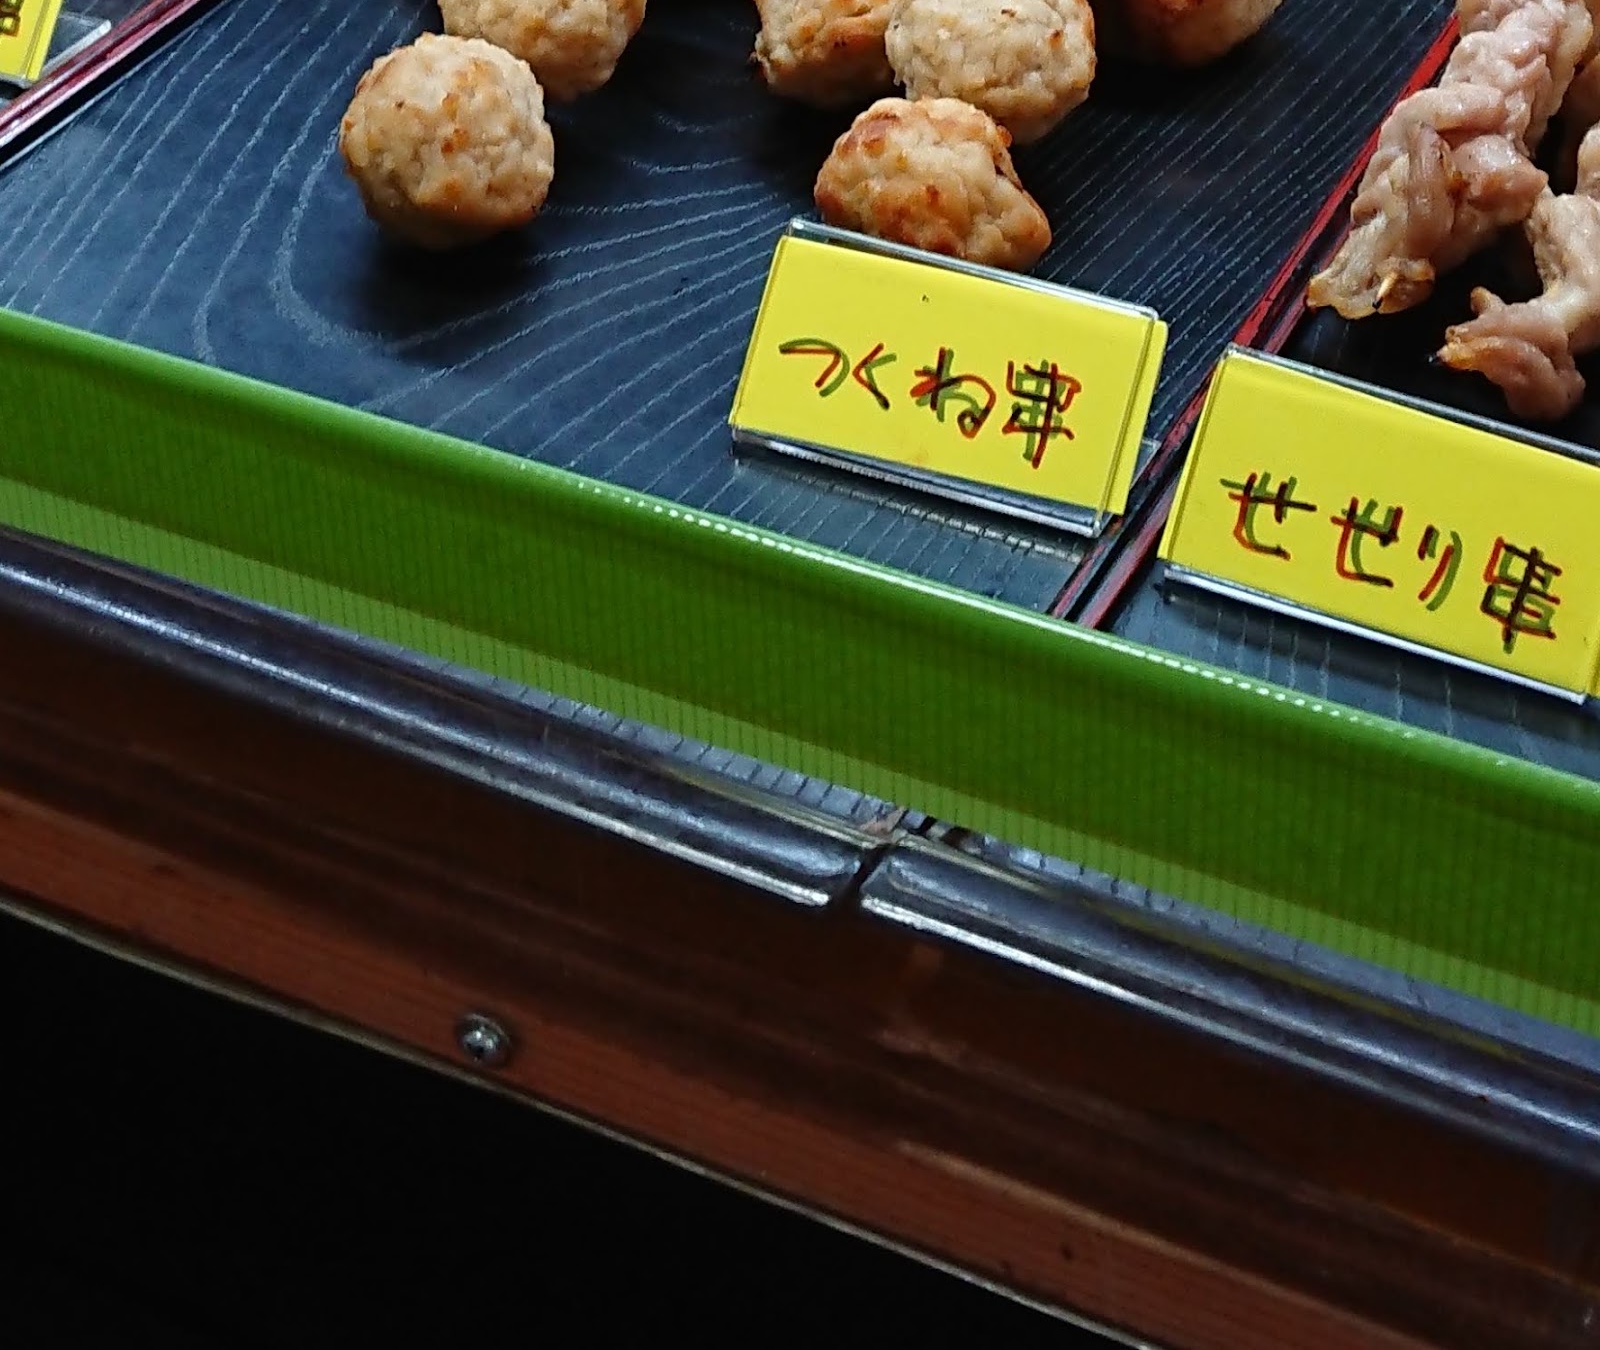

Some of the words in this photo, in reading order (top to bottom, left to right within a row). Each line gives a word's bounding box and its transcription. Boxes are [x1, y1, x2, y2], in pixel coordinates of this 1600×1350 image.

[778, 337, 1083, 470] つくね串
[1219, 471, 1563, 655] せせり串
